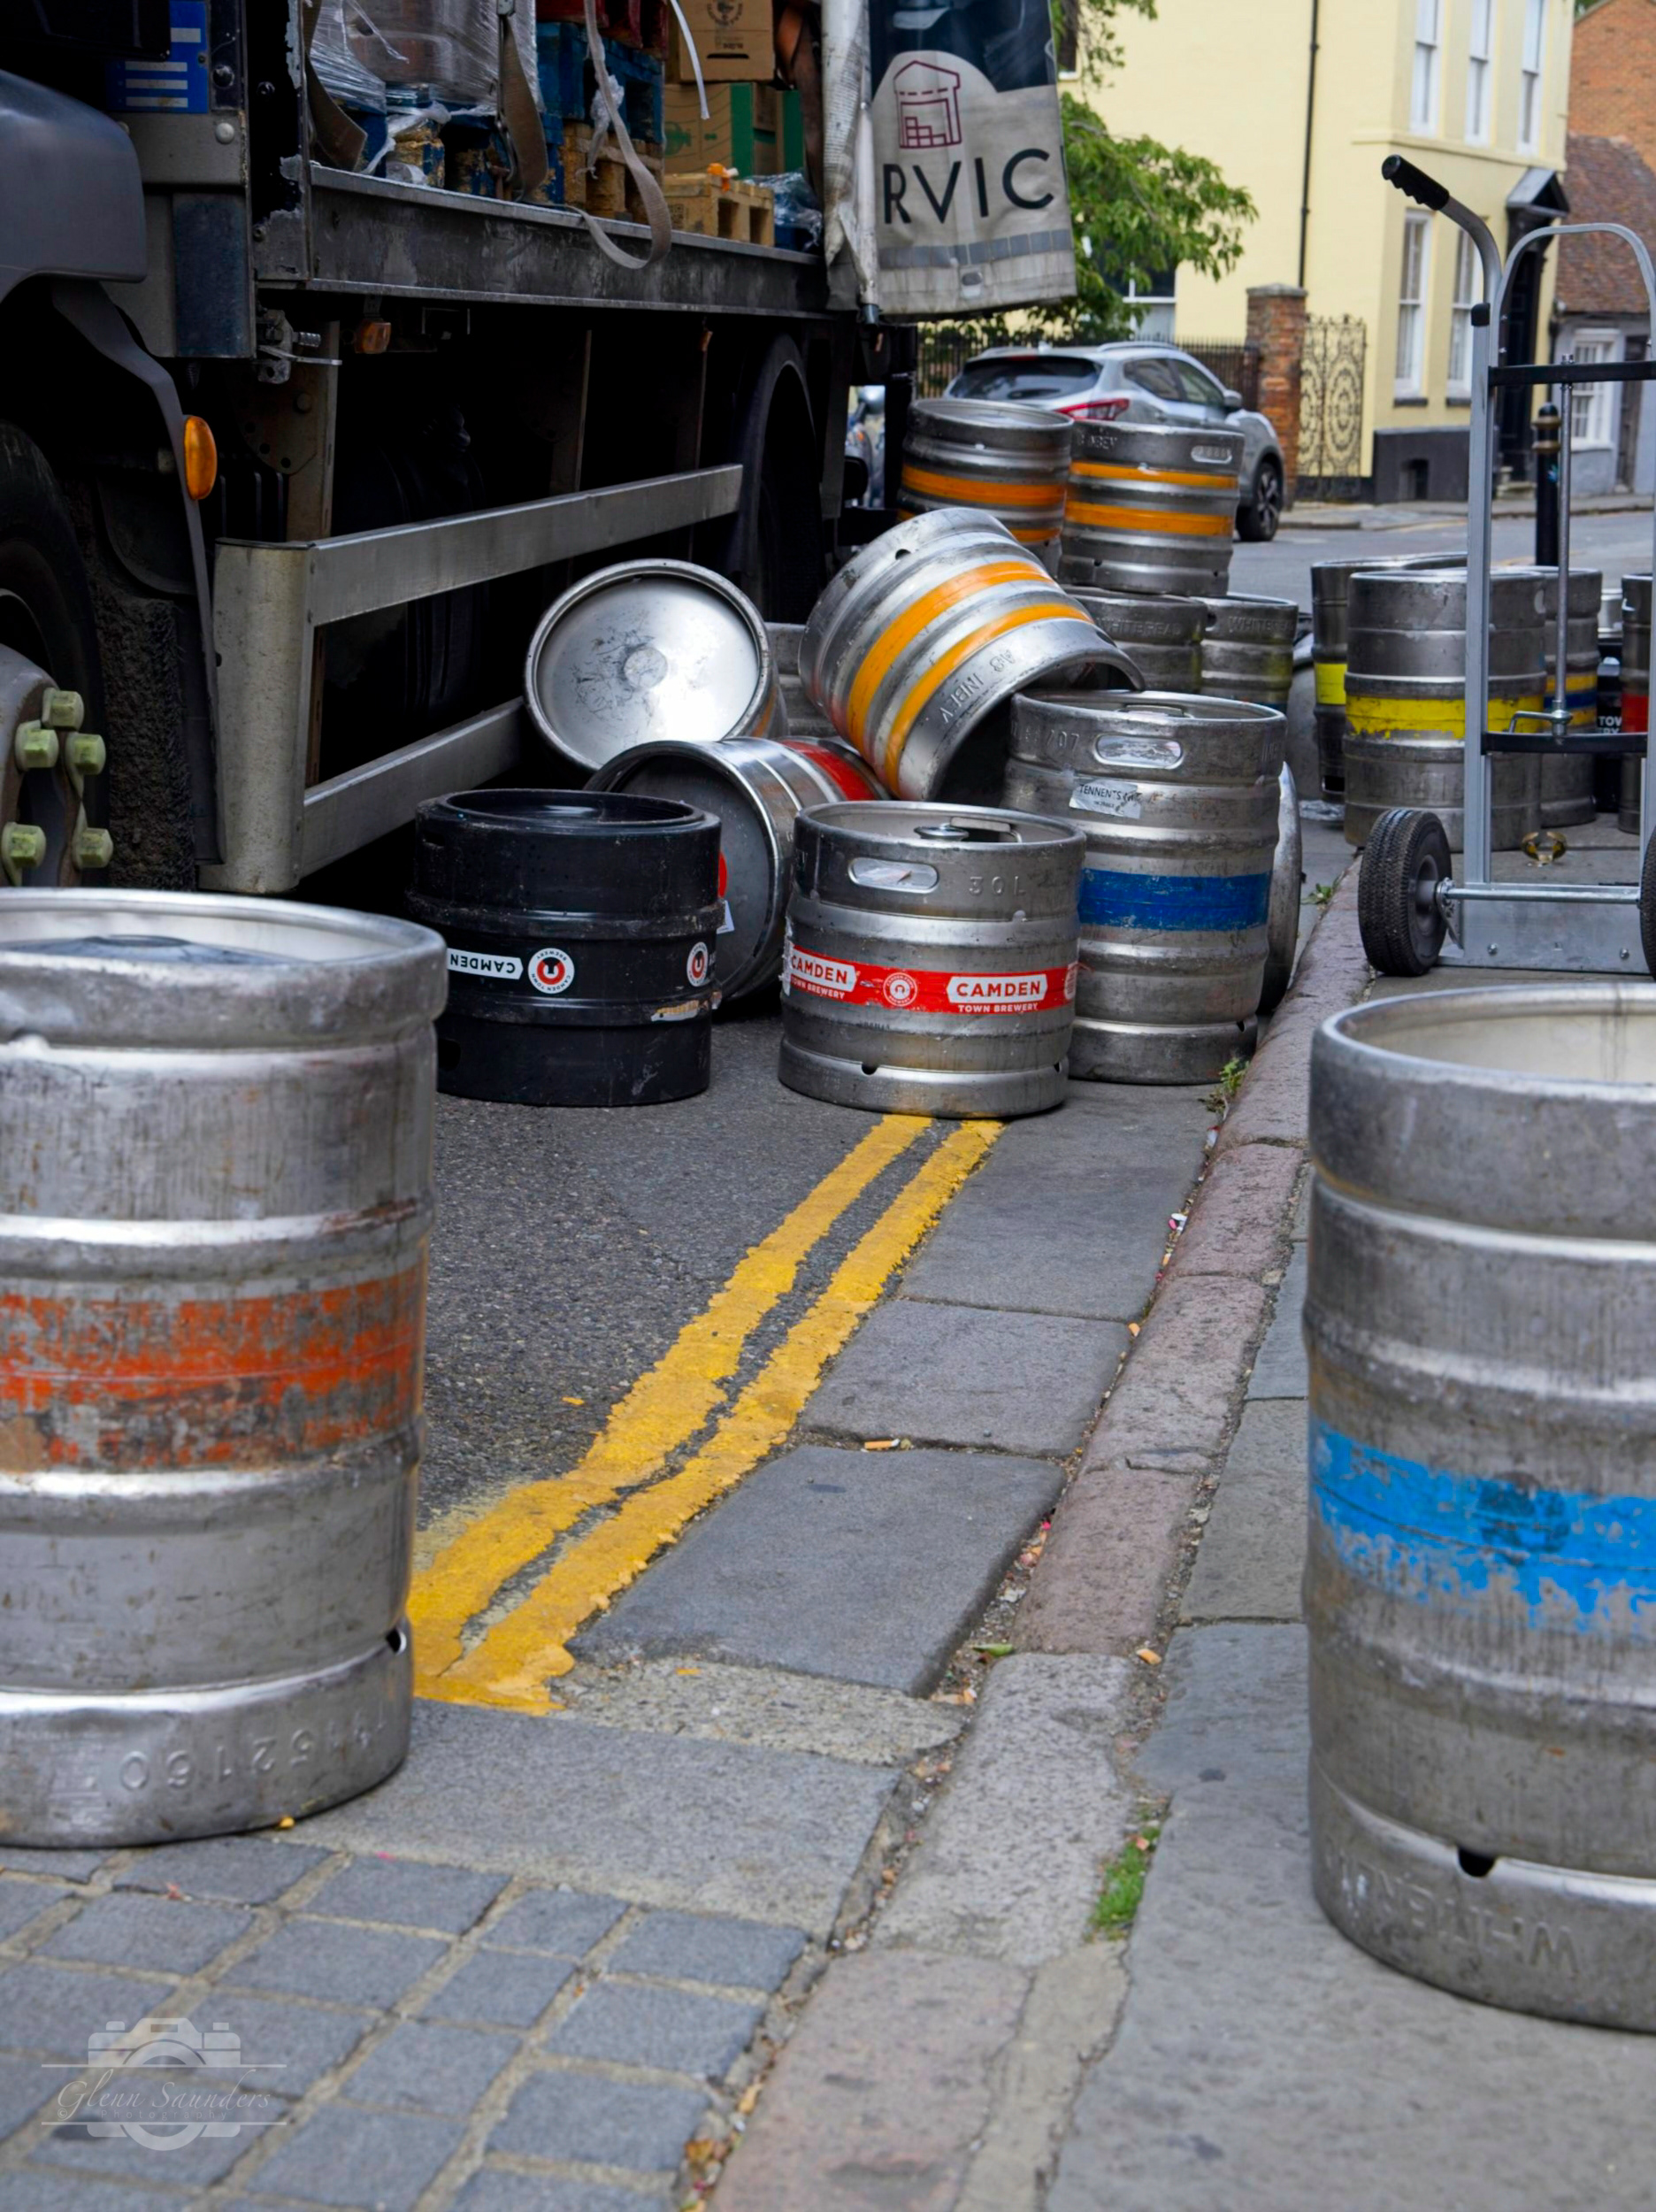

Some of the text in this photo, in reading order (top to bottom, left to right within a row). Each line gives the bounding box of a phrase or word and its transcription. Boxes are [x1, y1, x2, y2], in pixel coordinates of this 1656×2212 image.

[883, 146, 1066, 224] RVIC
[450, 953, 516, 974] CAMDEN
[791, 955, 847, 985] CAMDEN
[807, 982, 846, 1000] BREWERY
[956, 980, 1040, 997] CAMDEN
[957, 1002, 1039, 1013] TOWN BREWERY
